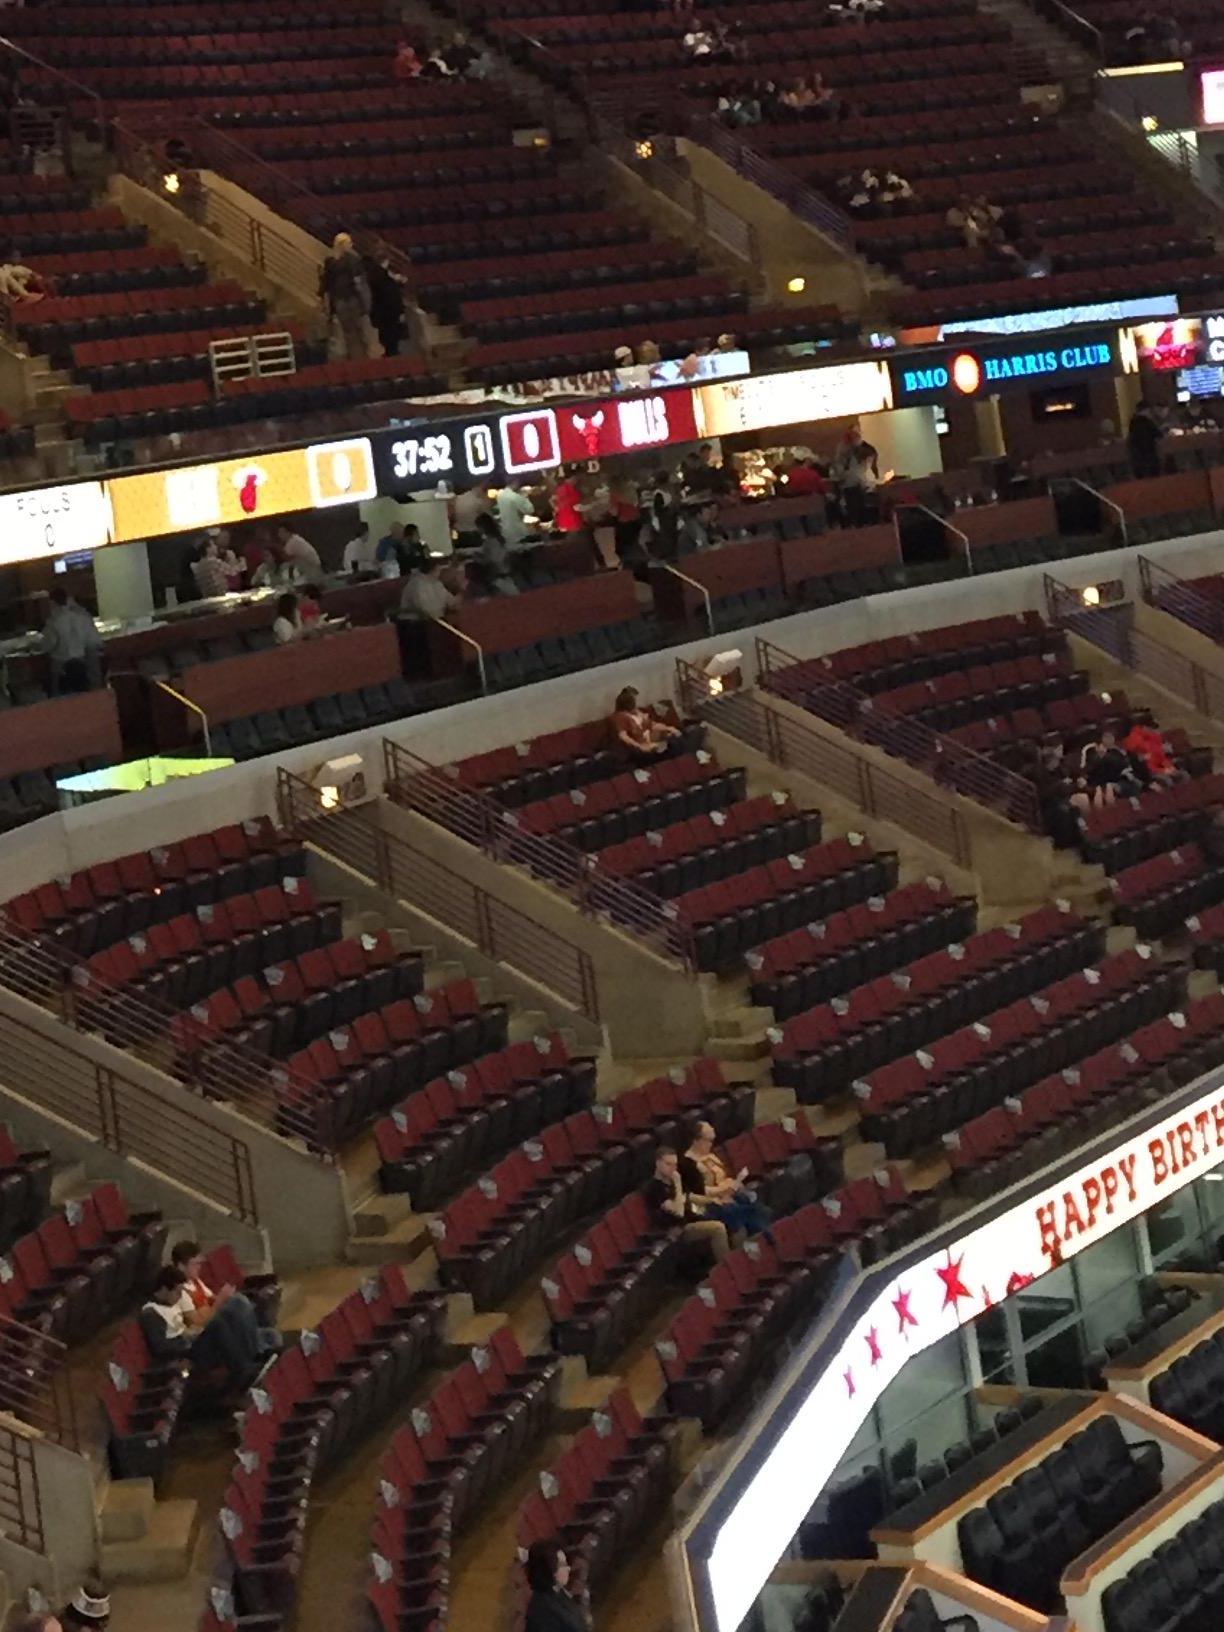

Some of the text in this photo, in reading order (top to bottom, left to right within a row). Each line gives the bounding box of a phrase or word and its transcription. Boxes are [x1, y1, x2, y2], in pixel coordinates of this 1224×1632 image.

[903, 342, 1111, 393] BMO HARRIS CLUB
[391, 433, 453, 478] 37:52
[473, 434, 485, 462] 1
[523, 423, 540, 458] 0
[1036, 1153, 1137, 1258] HAPPY
